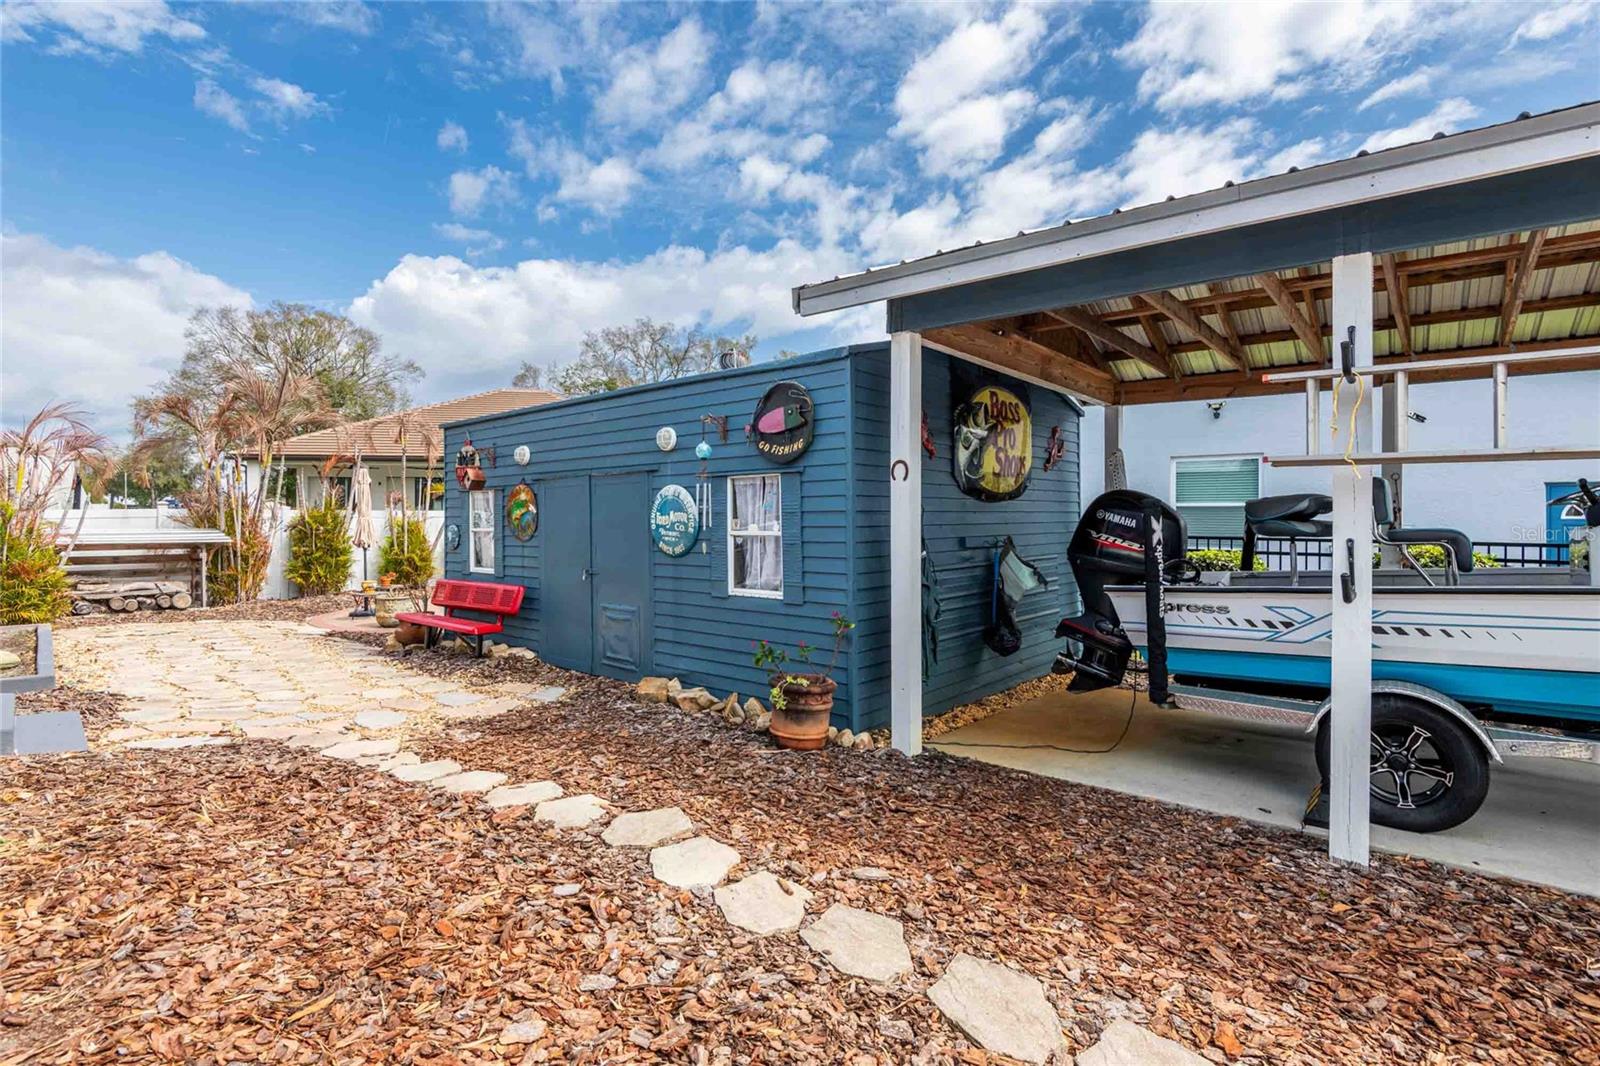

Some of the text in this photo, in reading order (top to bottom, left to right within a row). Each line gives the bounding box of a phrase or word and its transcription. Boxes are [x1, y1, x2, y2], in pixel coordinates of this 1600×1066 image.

[989, 390, 1020, 423] Bass
[758, 438, 804, 455] GO FISHING
[1104, 511, 1137, 529] YAMAHA
[1164, 601, 1230, 615] press
